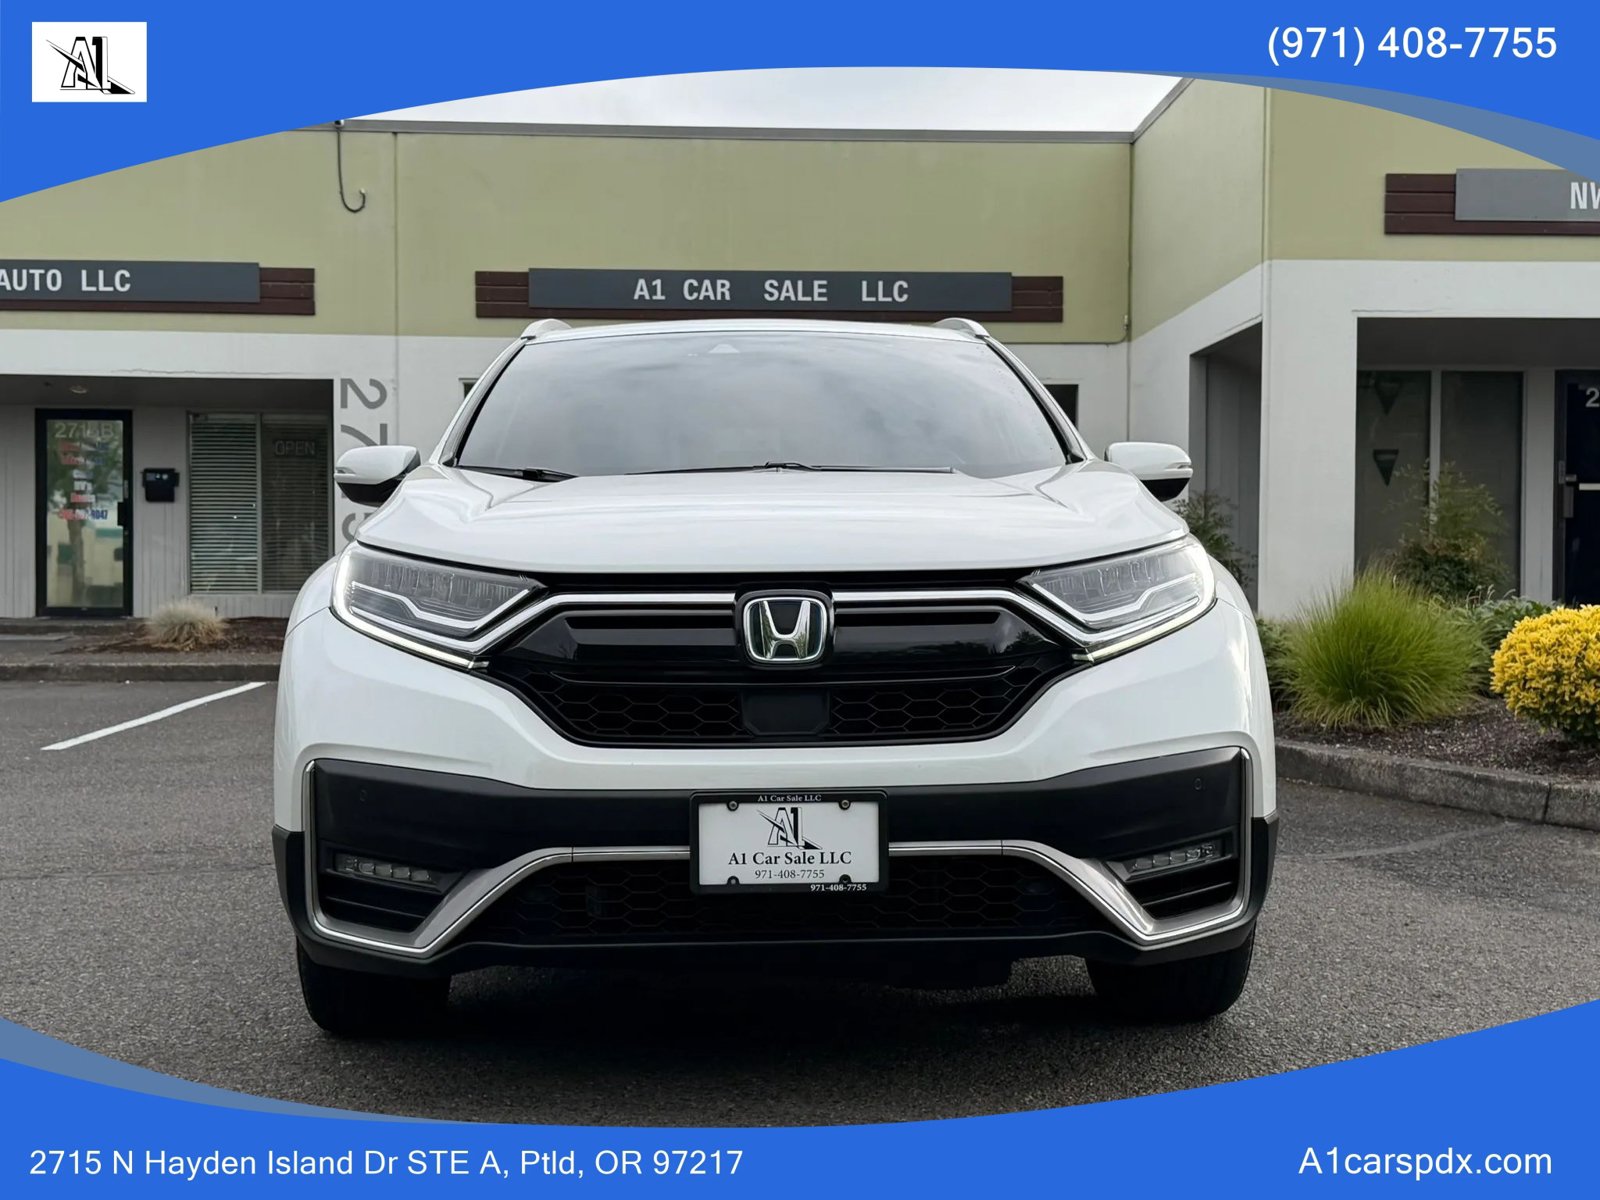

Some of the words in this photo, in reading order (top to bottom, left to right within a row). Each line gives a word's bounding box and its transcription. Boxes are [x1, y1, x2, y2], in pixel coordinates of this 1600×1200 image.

[80, 269, 132, 293] LLC
[633, 278, 666, 300] A1
[683, 278, 731, 301] CAR
[763, 279, 828, 302] SALE
[861, 280, 909, 303] LLC
[275, 439, 316, 456] OPEN
[786, 794, 803, 802] Sale
[728, 852, 747, 865] A1
[752, 851, 781, 865] Car
[784, 850, 815, 865] Sale
[819, 851, 852, 865] LLC
[754, 869, 825, 880] 971-408-7755
[810, 883, 867, 892] 971-408-7755
